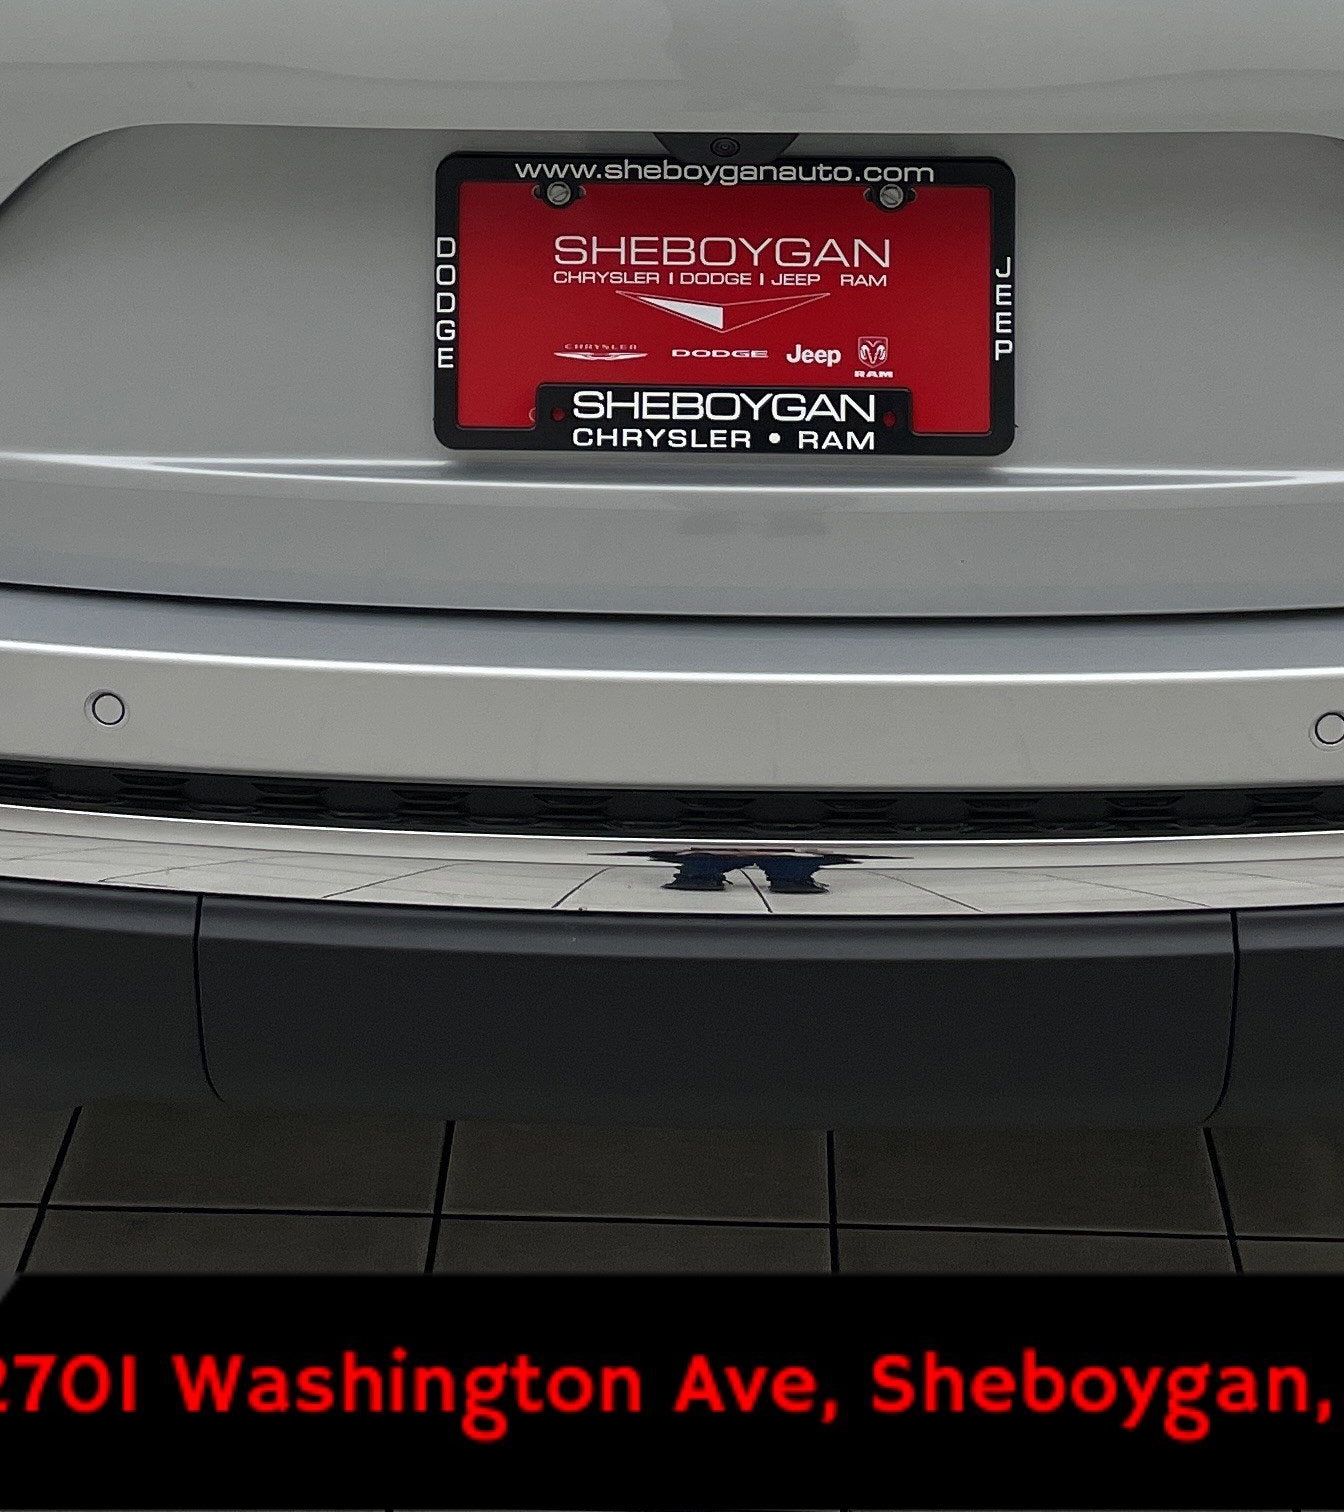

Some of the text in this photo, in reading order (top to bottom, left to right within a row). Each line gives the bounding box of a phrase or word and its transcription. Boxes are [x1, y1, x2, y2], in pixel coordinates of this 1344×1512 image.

[515, 159, 934, 186] www.sheboyganauto.com
[554, 235, 890, 268] SHEBOYGAN
[553, 271, 887, 287] CHRYSLER DODGE JEEP RAM
[435, 236, 456, 369] DODGE
[994, 256, 1013, 361] JEEP
[671, 349, 769, 358] DODGE
[786, 344, 842, 368] Jeep
[853, 370, 894, 378] RAM
[572, 390, 876, 423] SHEBOYGAN
[573, 427, 875, 451] CHRYSLER RAM
